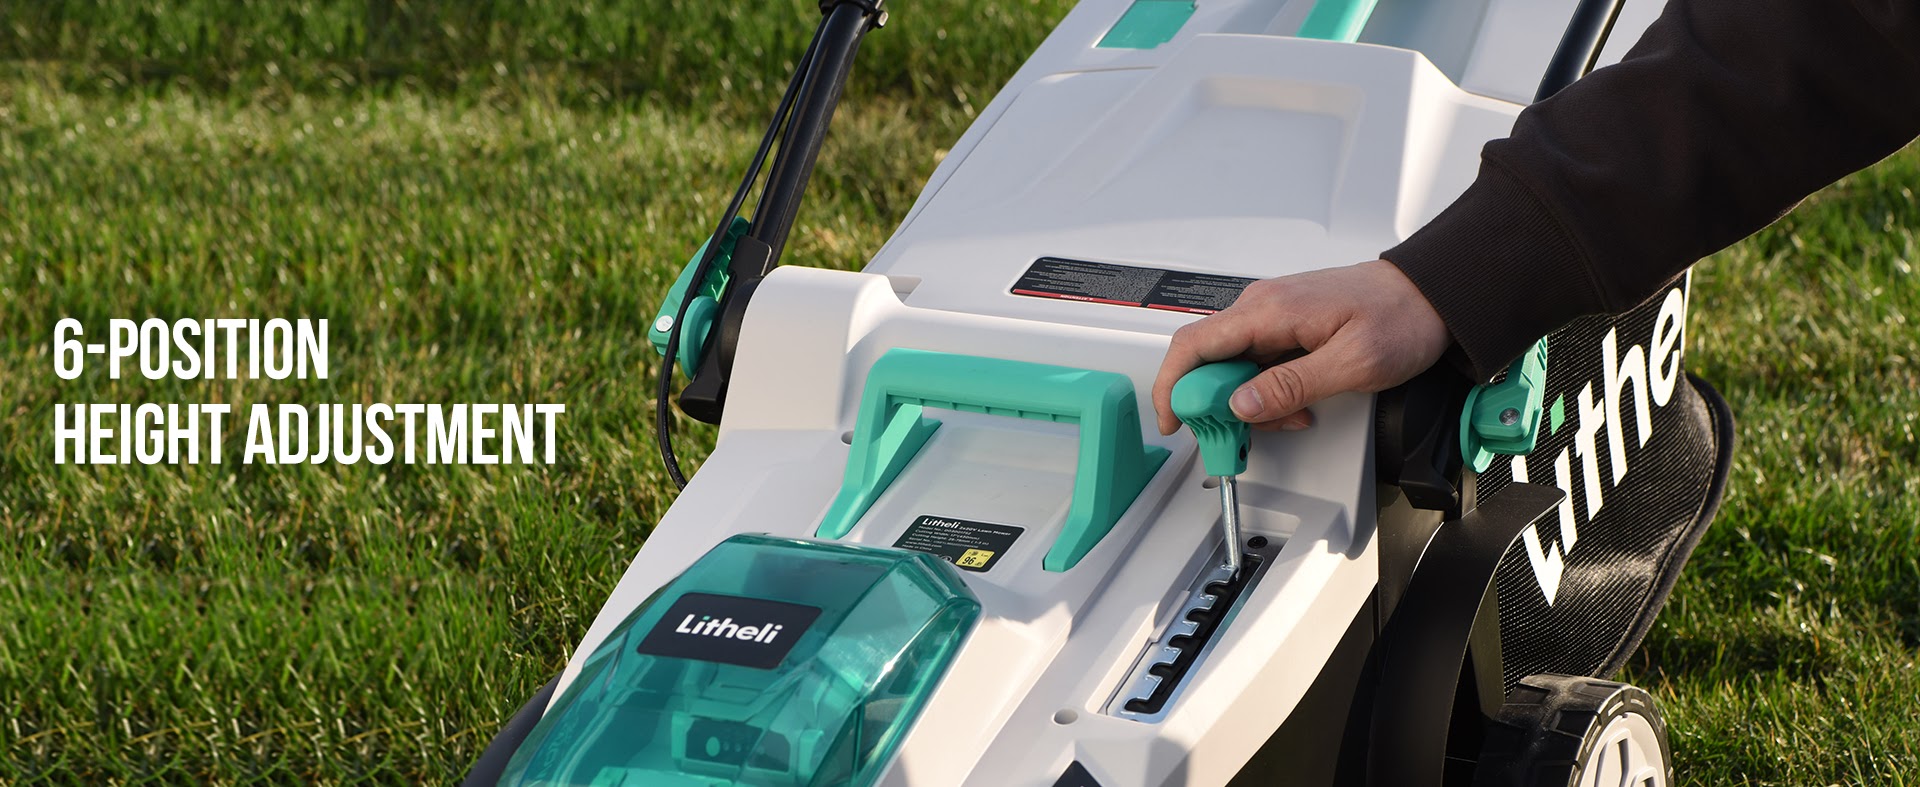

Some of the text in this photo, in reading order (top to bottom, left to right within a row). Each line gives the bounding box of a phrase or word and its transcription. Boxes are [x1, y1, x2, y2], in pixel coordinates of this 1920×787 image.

[922, 518, 961, 529] Litheli
[962, 556, 977, 565] 96
[1200, 593, 1214, 601] 5
[675, 614, 783, 644] Litheli
